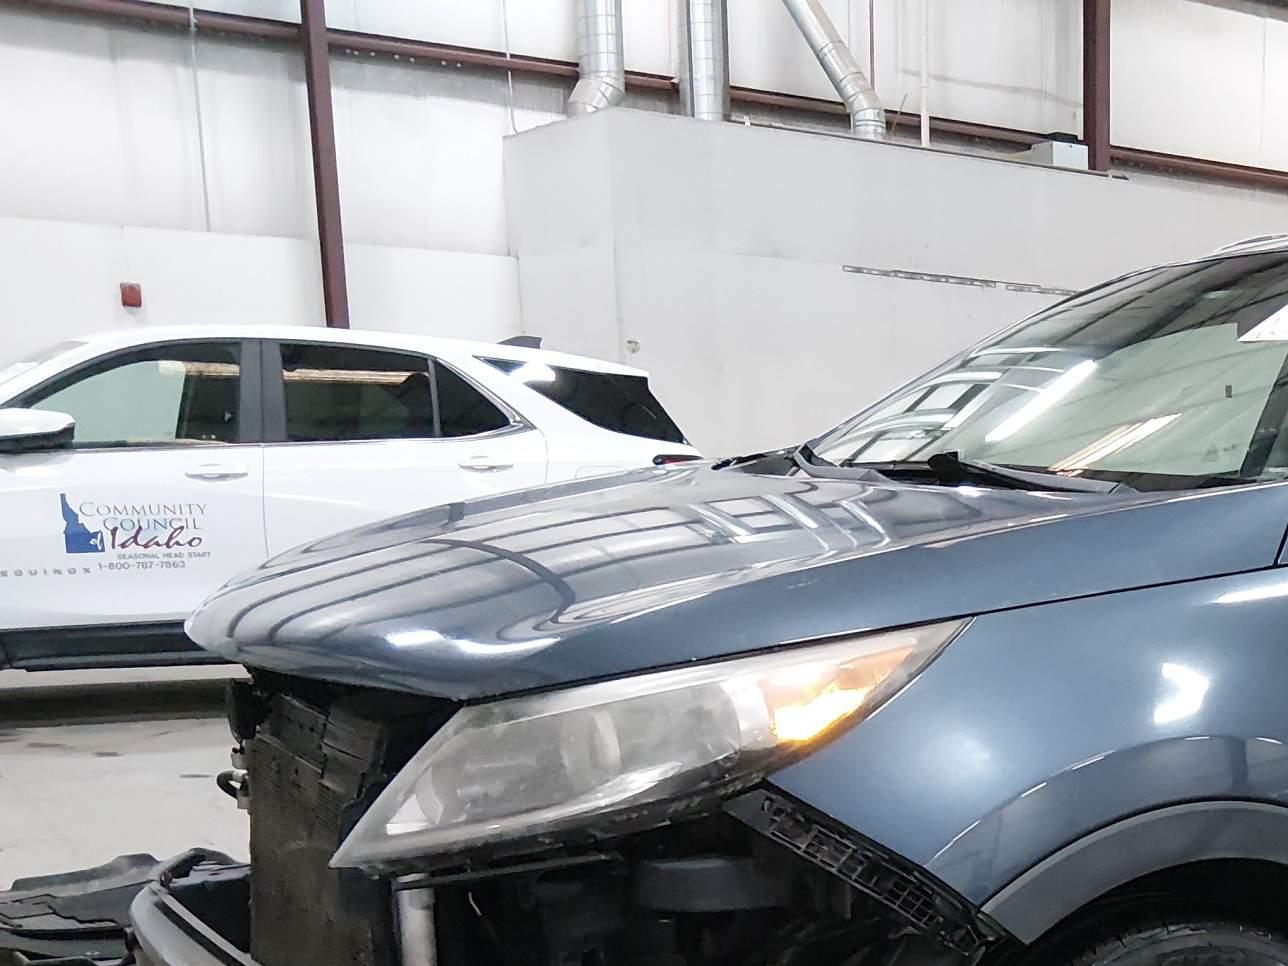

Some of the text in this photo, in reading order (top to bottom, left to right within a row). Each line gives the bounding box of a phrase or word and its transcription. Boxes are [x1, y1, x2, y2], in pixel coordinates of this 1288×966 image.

[79, 501, 207, 517] COMMUNITY
[103, 516, 203, 532] COUNCIL
[110, 525, 203, 549] Idaho
